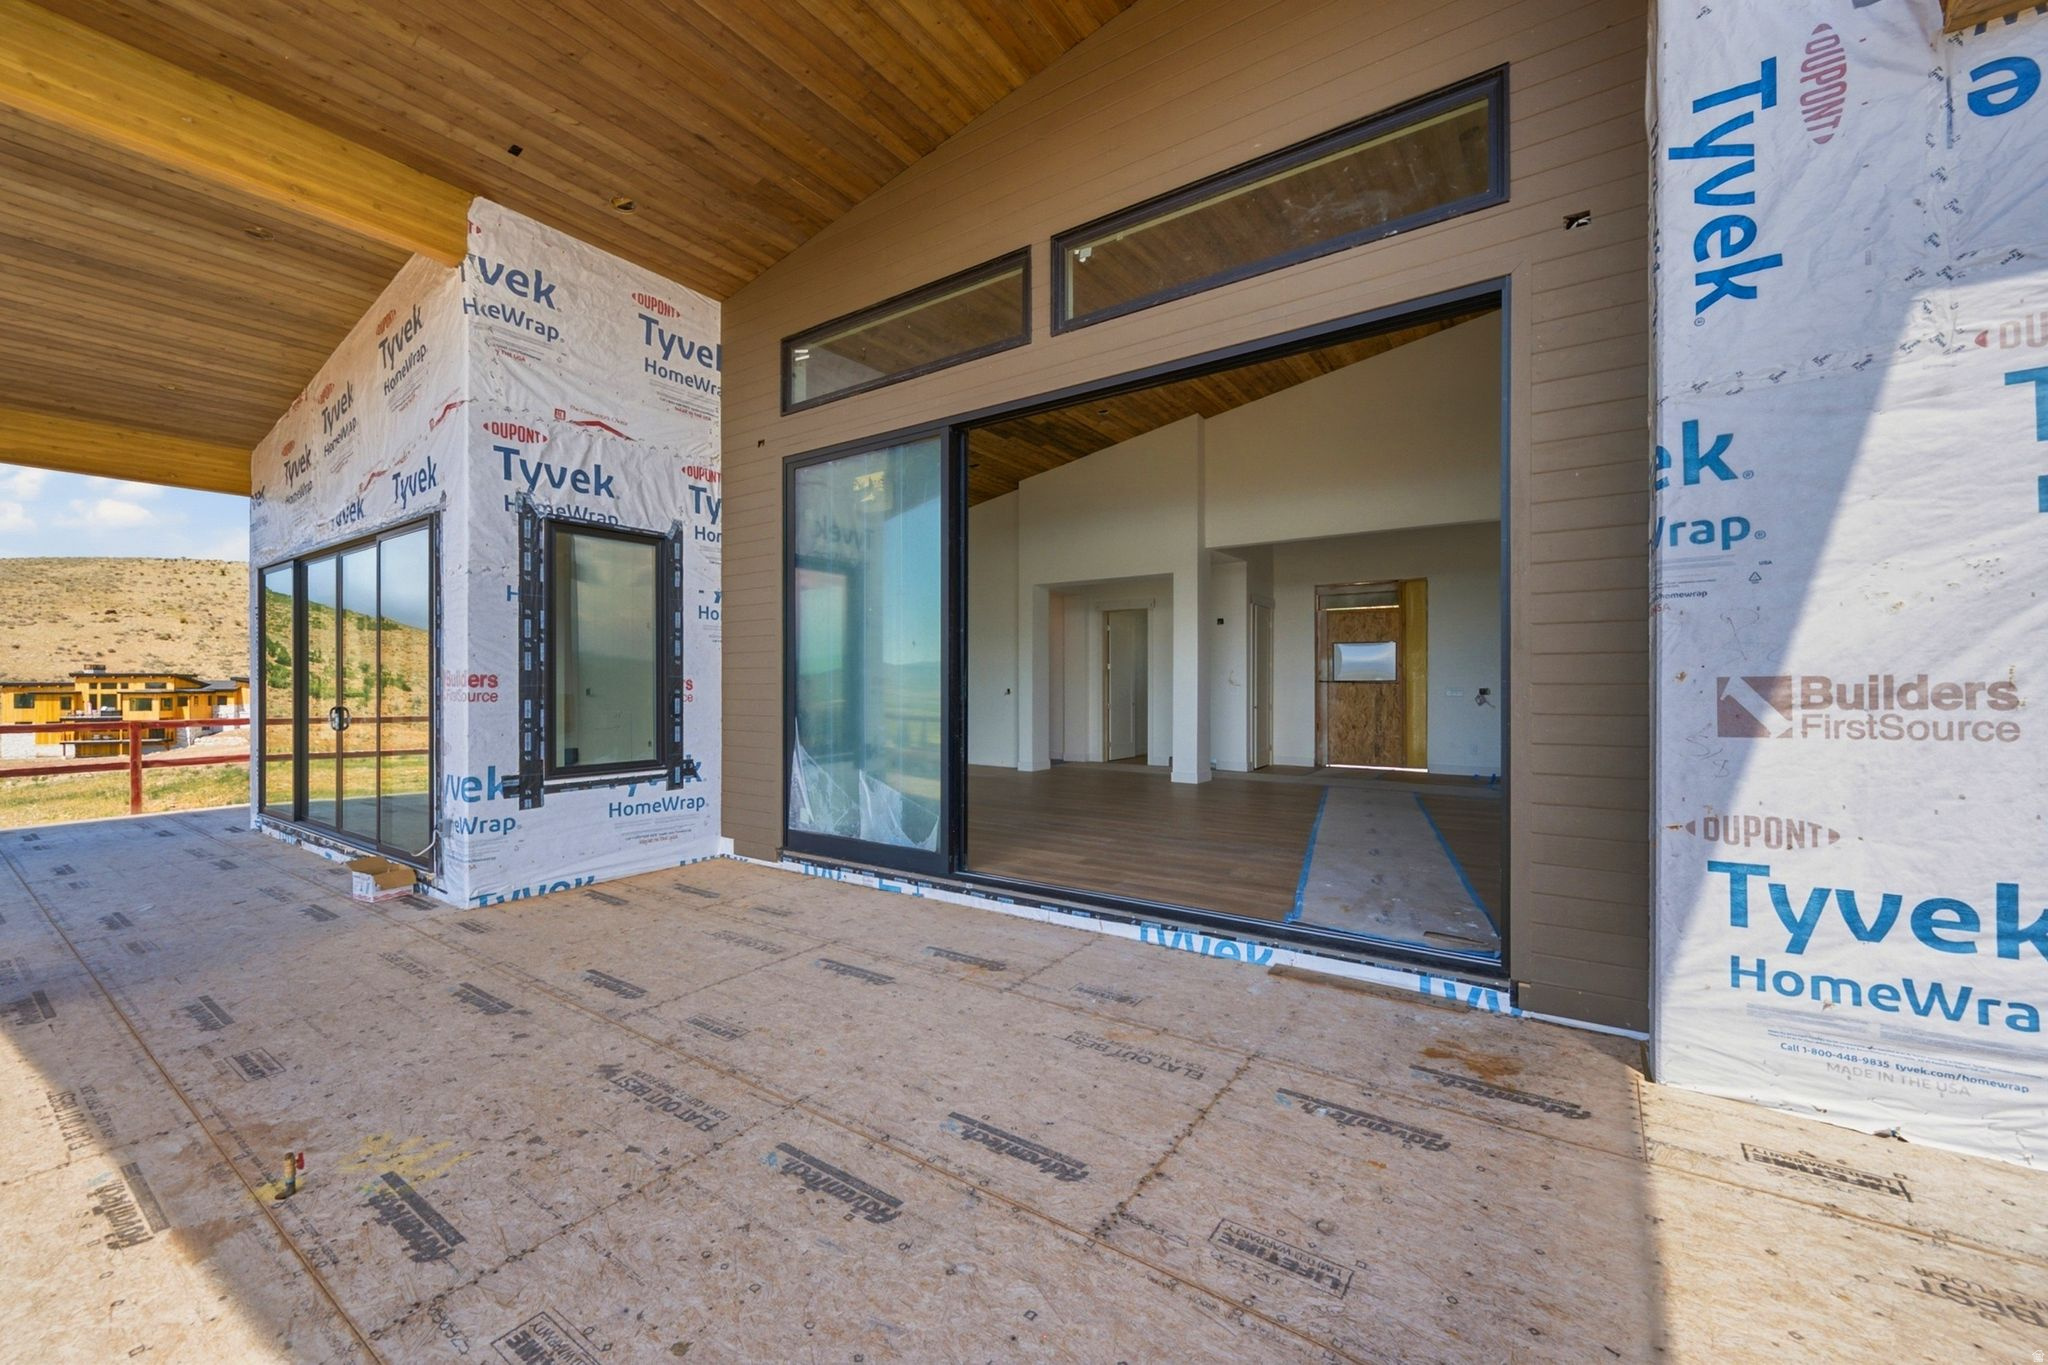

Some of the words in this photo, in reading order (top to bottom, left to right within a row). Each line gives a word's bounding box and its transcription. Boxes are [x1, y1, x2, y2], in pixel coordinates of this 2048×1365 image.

[1799, 33, 1847, 132] DUPONT
[1668, 56, 1783, 315] Tyvek
[637, 293, 676, 318] DUPONT
[379, 304, 423, 370] Tyvek
[322, 380, 353, 436] Tyvek
[491, 422, 541, 444] DUPONT
[284, 443, 311, 489] Tyvek
[392, 456, 437, 510] Tyvek
[493, 445, 615, 499] Tyvek
[1800, 674, 2020, 712] Builders
[1801, 714, 2021, 743] FirstSource
[609, 796, 705, 818] HomeWrap
[1704, 814, 1823, 850] DUPONT
[1707, 860, 2048, 961] Tyvek
[1731, 955, 2041, 1034] HomeWra
[1780, 1041, 1800, 1053] Call
[1803, 1046, 1890, 1069] 1-800-448-9835
[1895, 1063, 2029, 1094] tyvek.com/homewrap
[1826, 1062, 1873, 1080] MADE
[1877, 1071, 1895, 1084] IN
[1298, 1100, 1452, 1152] AdvanTeh
